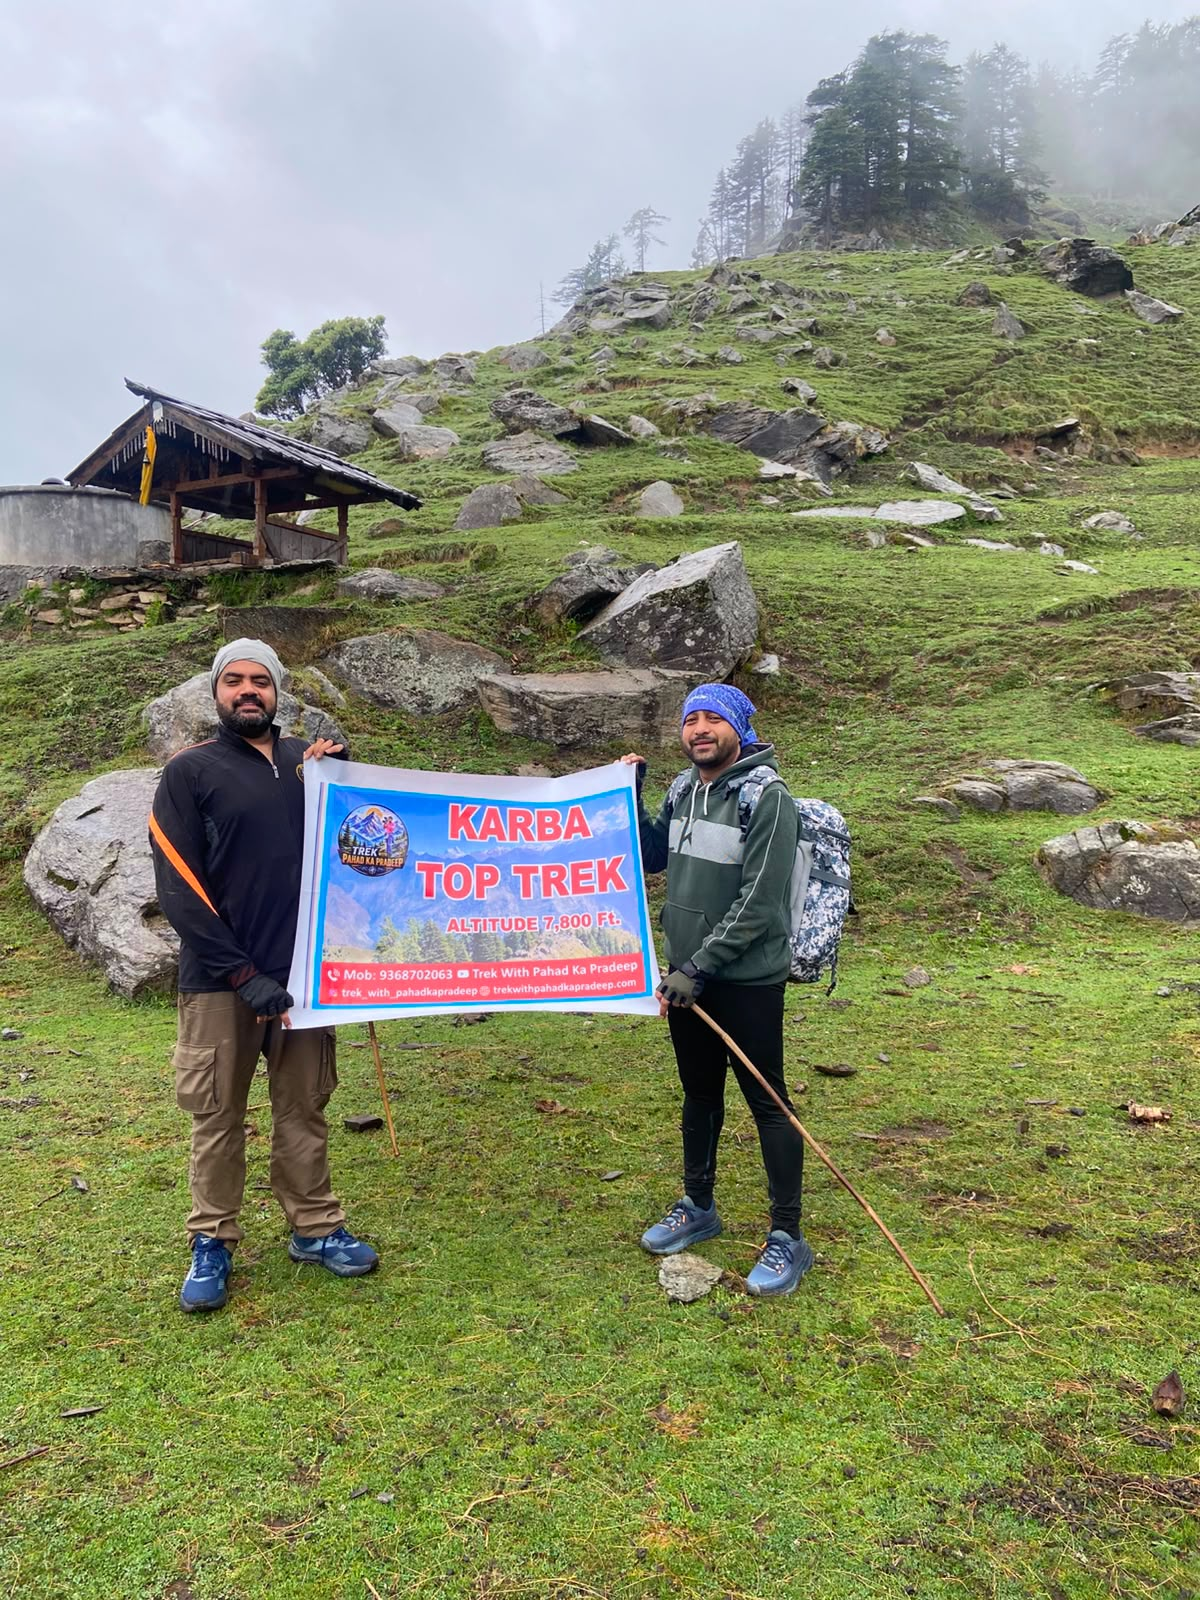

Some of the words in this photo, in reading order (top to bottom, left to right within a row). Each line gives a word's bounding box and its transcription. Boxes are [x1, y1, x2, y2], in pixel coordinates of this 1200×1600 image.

[449, 803, 592, 842] KARBA
[352, 847, 378, 856] TREK
[342, 854, 364, 864] PAHAD
[366, 856, 374, 865] KA
[376, 858, 403, 867] PRADEEP
[417, 861, 501, 900] TOP
[513, 854, 629, 899] TREK
[446, 917, 538, 933] ALTITUDE
[542, 914, 592, 932] 7,800
[597, 912, 621, 927] Ft.
[344, 969, 376, 981] Mob:
[379, 969, 453, 981] 9368702063
[472, 968, 498, 979] Trek
[500, 966, 529, 978] With
[533, 964, 568, 977] Pahad
[572, 963, 587, 974] Ka
[590, 961, 638, 976] Pradeep
[342, 986, 478, 998] trek_with_pahadkapradeep
[493, 979, 637, 994] trekwithpahadkapradeep.com
